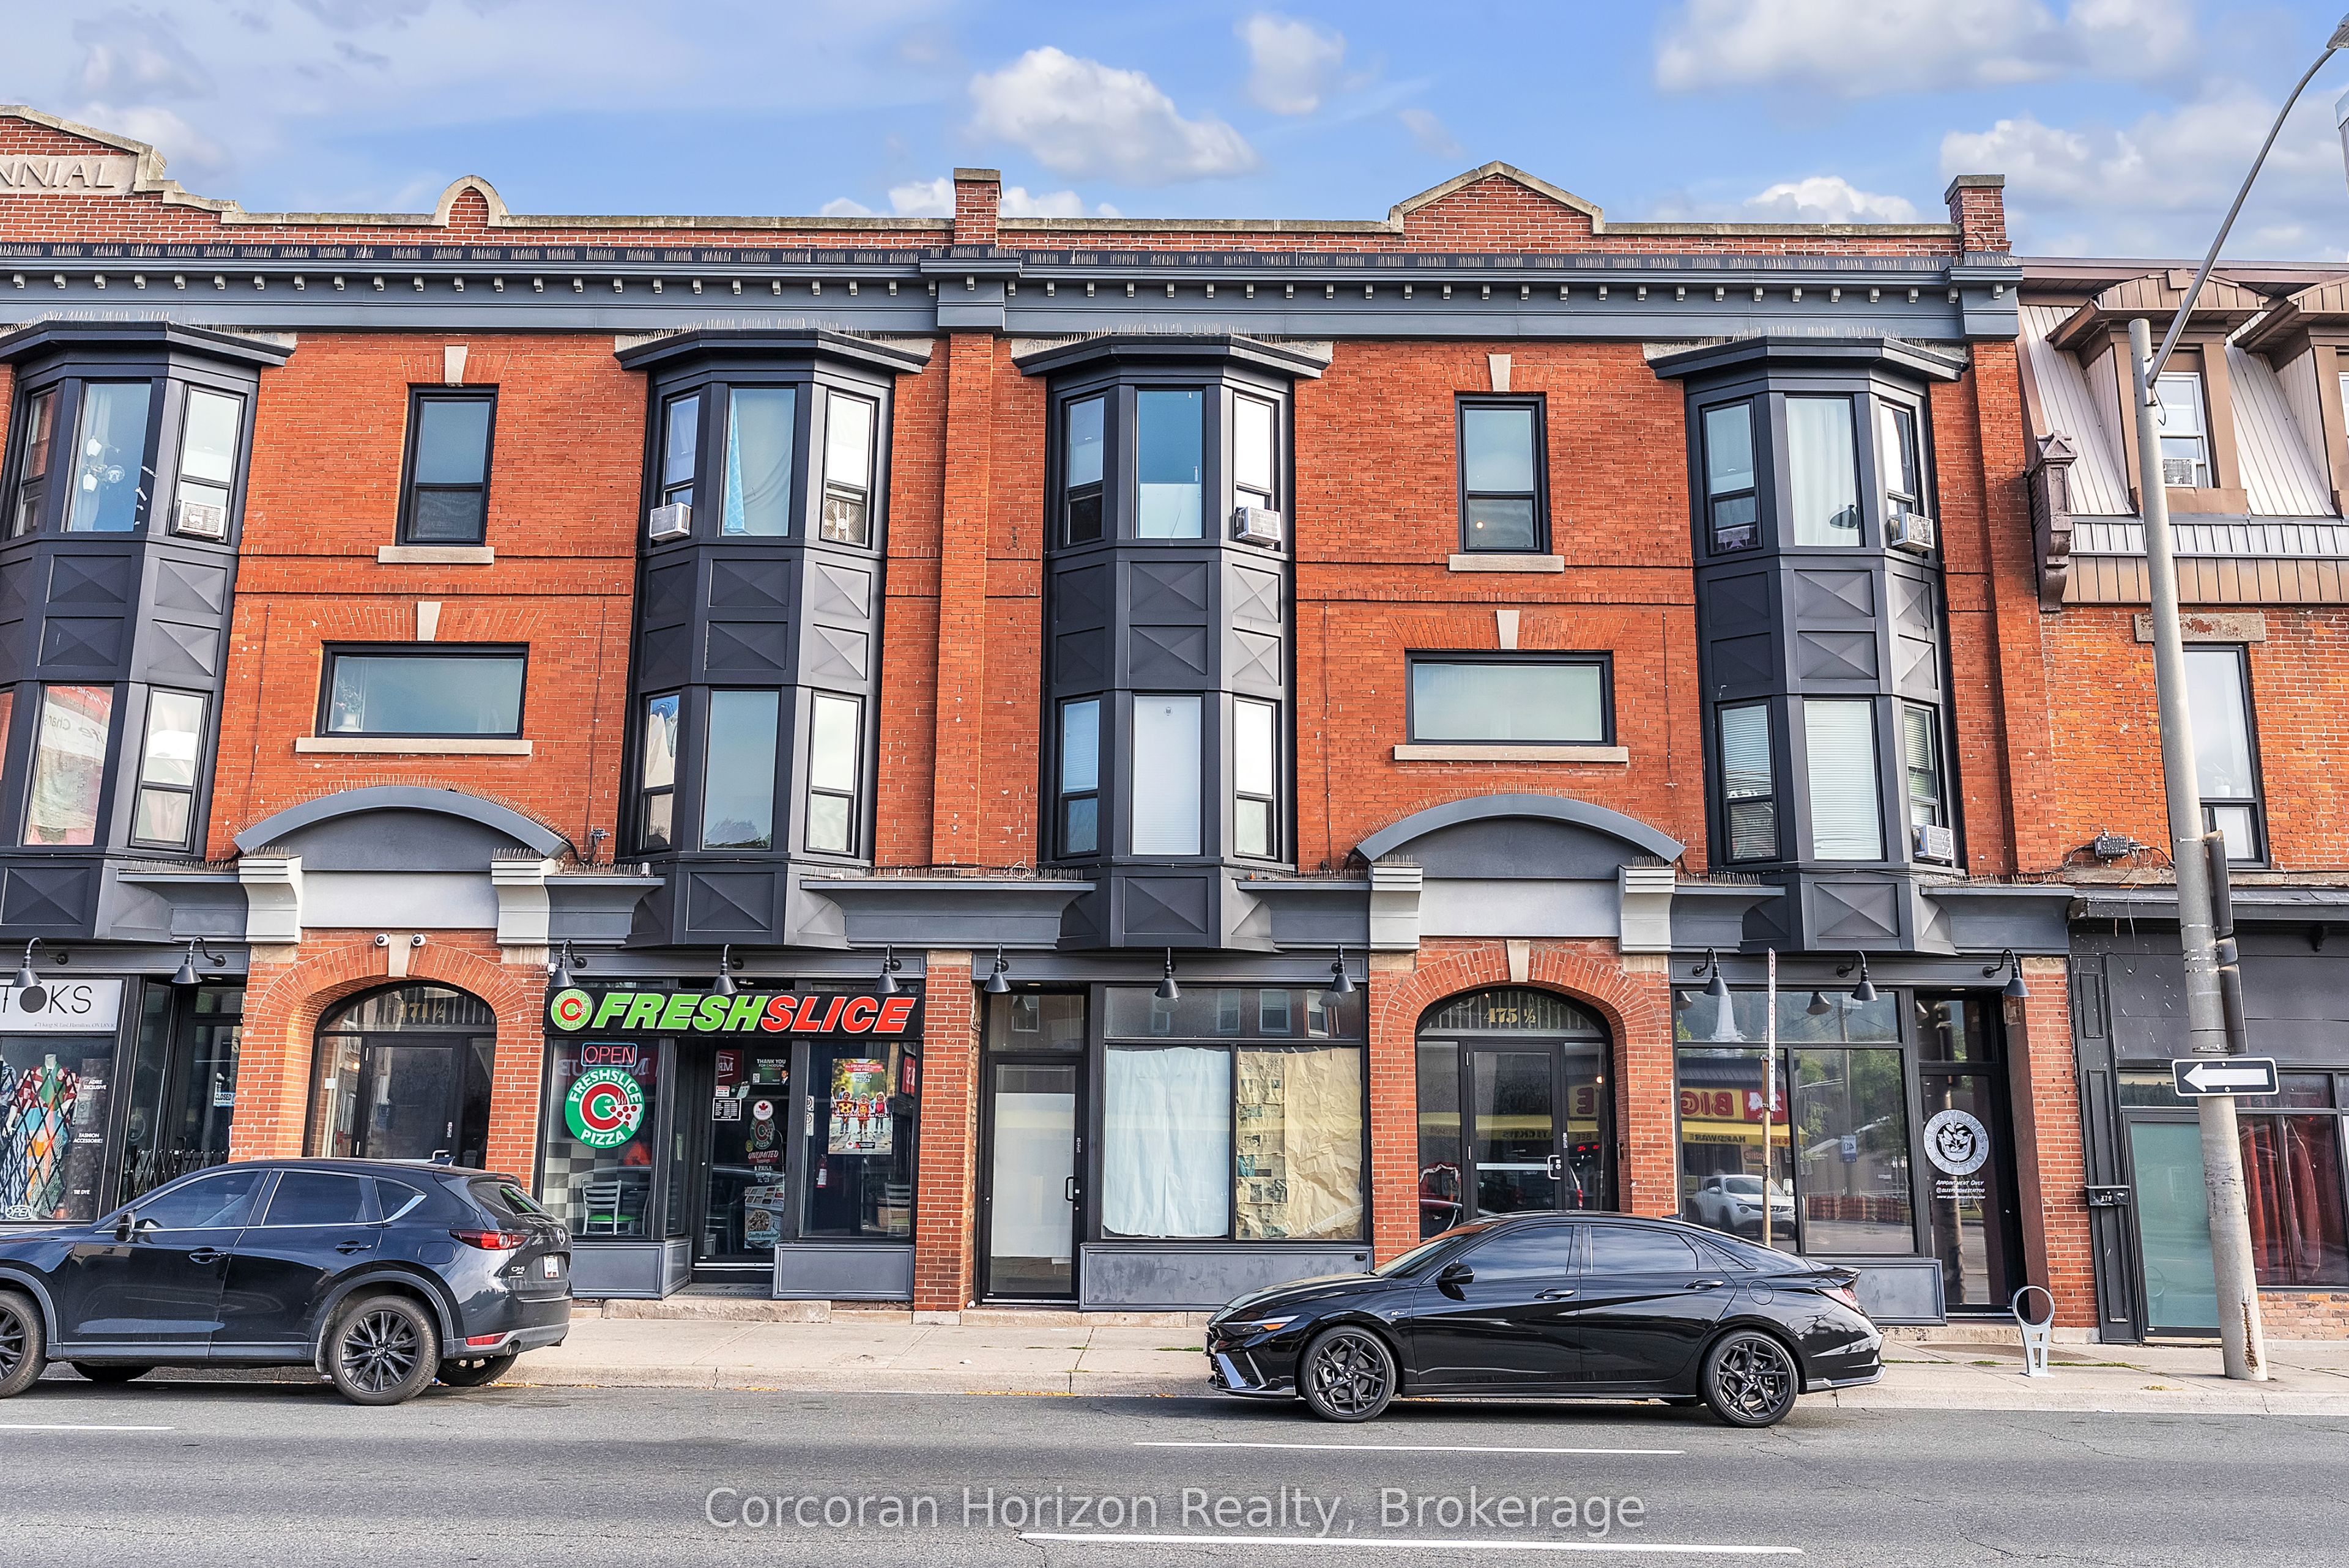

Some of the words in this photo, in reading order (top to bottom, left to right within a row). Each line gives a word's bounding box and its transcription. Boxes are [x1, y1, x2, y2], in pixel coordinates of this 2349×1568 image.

[1483, 1007, 1517, 1023] 475
[584, 1046, 636, 1063] OPEN
[568, 1069, 642, 1103] FRESHSLICE
[1924, 1111, 1988, 1143] SLEEPYBONES
[580, 1129, 626, 1145] PIZZA
[748, 1150, 779, 1160] UNLIMITED
[1932, 1152, 1985, 1174] TATTOO
[6, 1207, 33, 1217] OPEN
